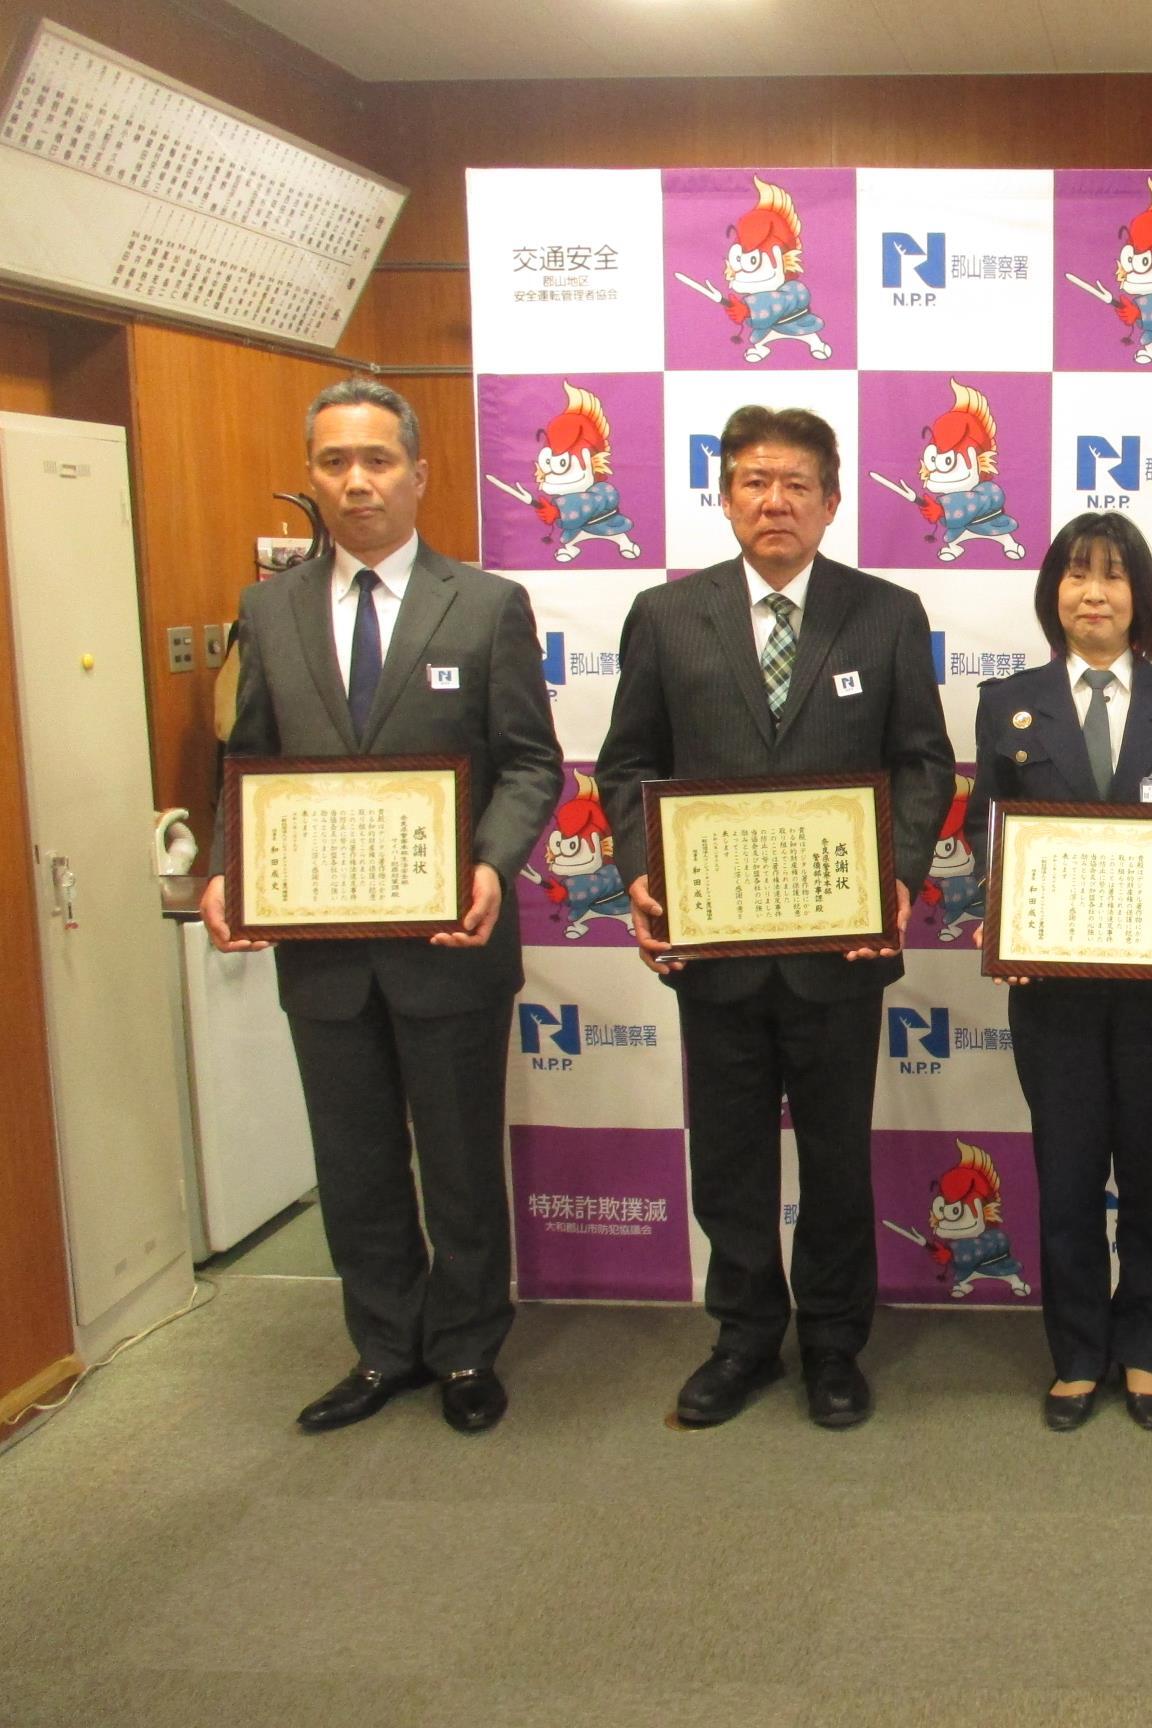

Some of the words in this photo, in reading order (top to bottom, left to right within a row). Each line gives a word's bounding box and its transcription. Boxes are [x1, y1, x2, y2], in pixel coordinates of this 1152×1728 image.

[512, 244, 618, 272] 交通安全
[951, 254, 1028, 280] 郡山警察署
[543, 275, 589, 287] 郡山地区
[893, 292, 936, 307] N.P.P.
[1087, 495, 1130, 509] N.P.P.
[950, 652, 1026, 676] 郡山警察署
[412, 825, 428, 875] 感謝状
[834, 842, 851, 890] 感謝状
[585, 1024, 657, 1047] 郡山警察署
[532, 1057, 573, 1071] N.P.P.
[900, 1062, 942, 1074] N.P.P.
[528, 1193, 668, 1222] 特殊詐欺撲滅
